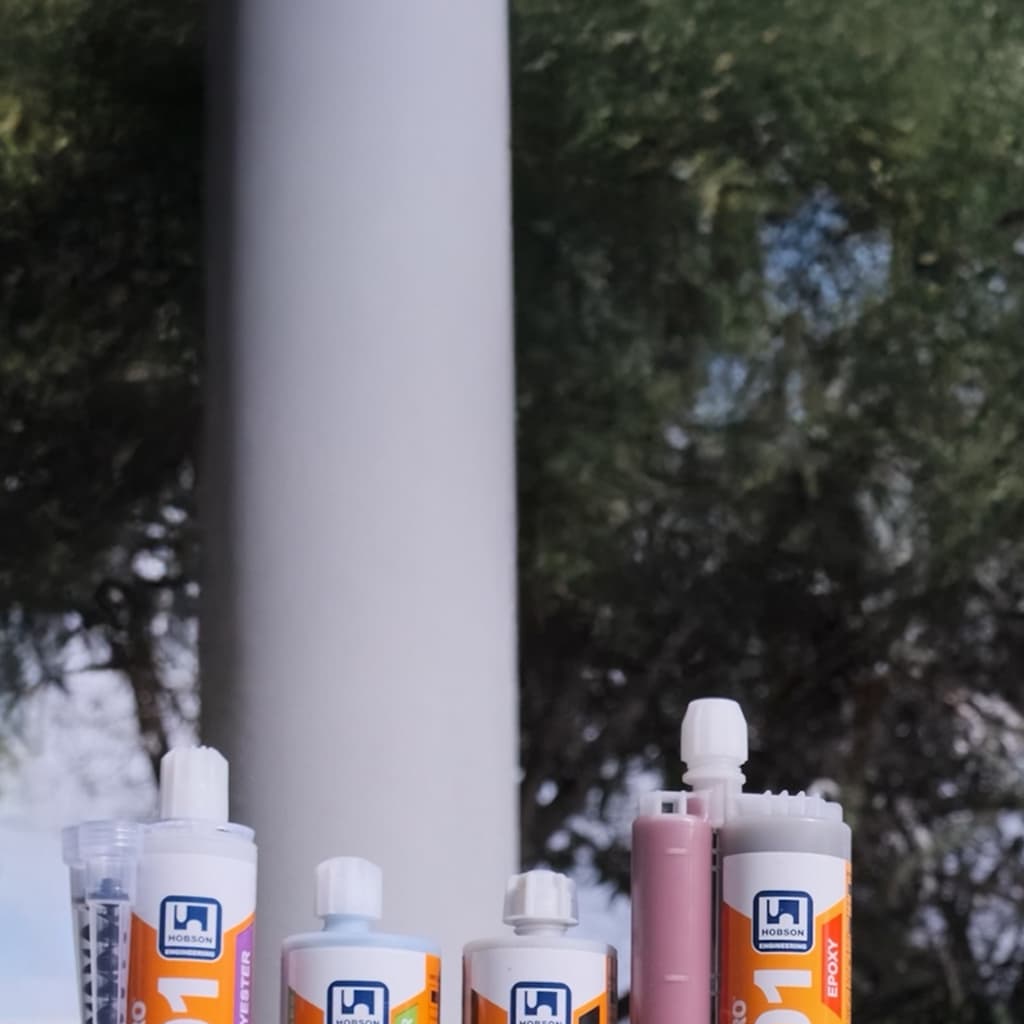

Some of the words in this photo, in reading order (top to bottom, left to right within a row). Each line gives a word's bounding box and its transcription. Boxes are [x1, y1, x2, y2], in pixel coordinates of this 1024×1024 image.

[761, 928, 805, 937] HOBSON
[168, 933, 213, 944] HOBSON
[827, 938, 840, 999] EPOXY
